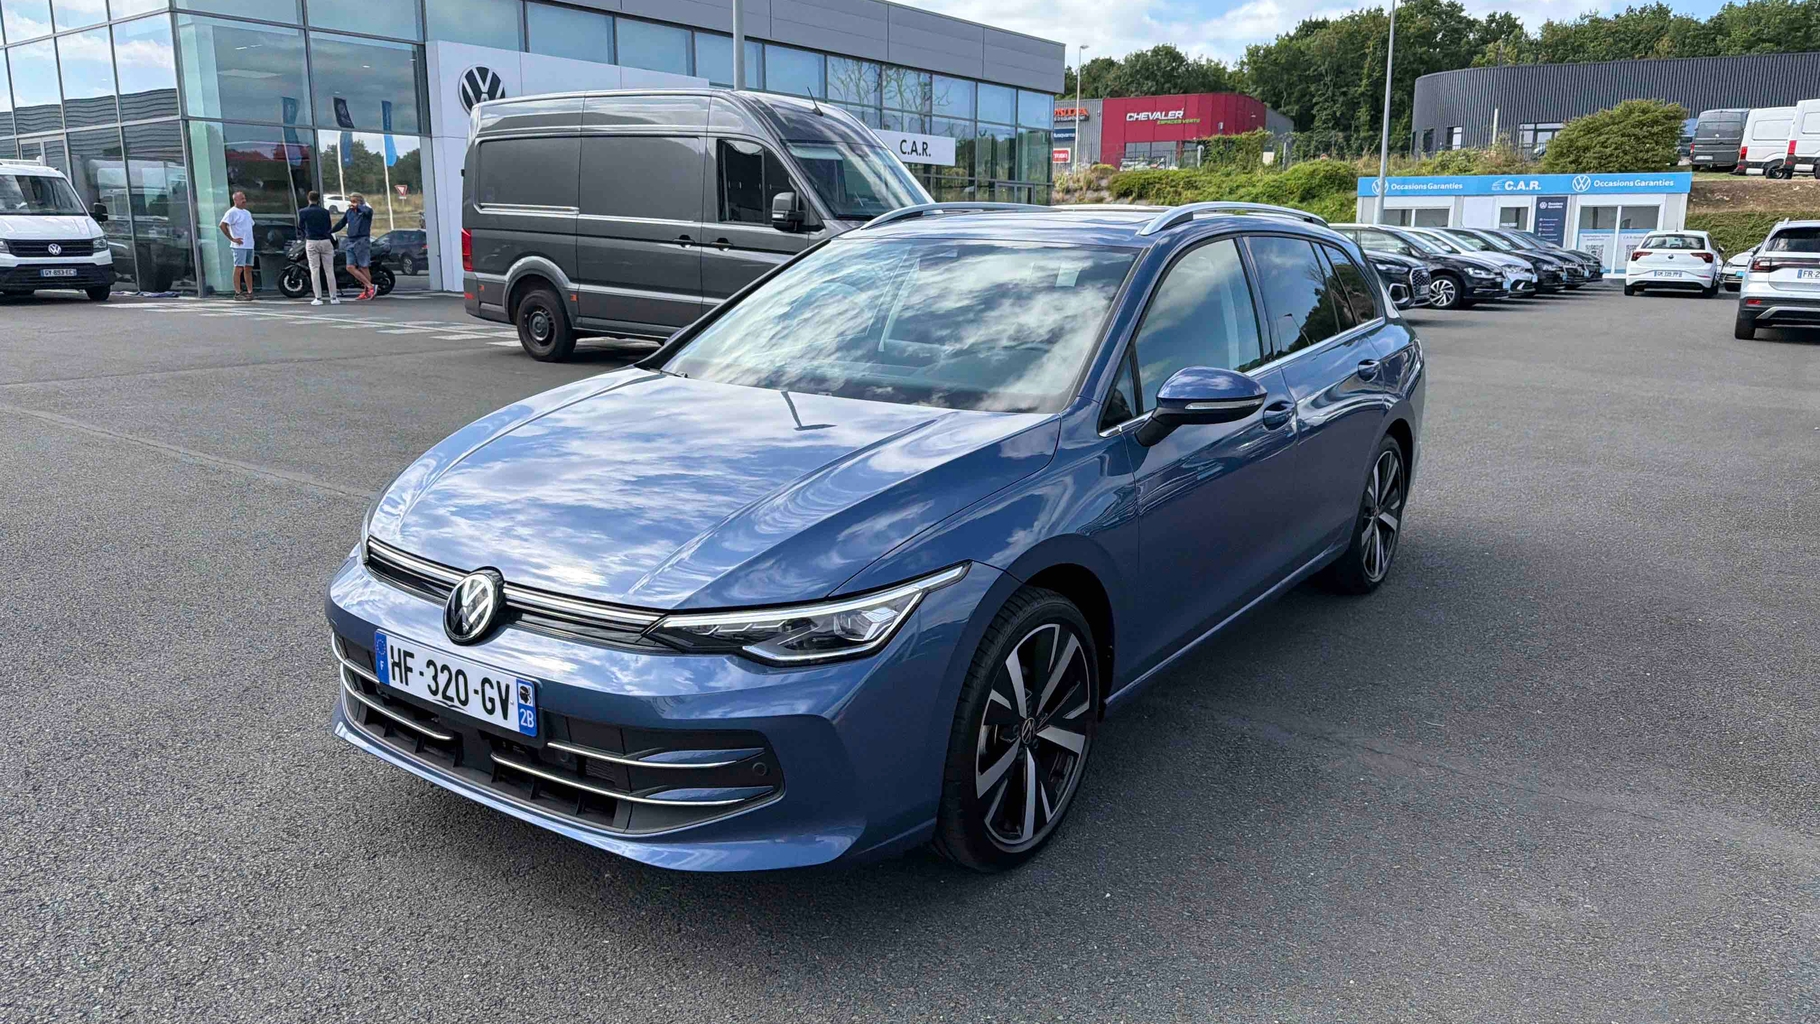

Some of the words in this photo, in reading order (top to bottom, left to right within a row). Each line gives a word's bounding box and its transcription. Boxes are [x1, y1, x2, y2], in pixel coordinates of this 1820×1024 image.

[899, 139, 931, 157] C.A.R.
[1427, 182, 1463, 190] Garanties
[1504, 180, 1542, 191] C.A.R.
[1593, 179, 1633, 187] Occasions
[1635, 179, 1674, 187] Garanties
[379, 660, 385, 670] F
[389, 644, 511, 721] HF-320-GV
[519, 708, 535, 728] 2B
